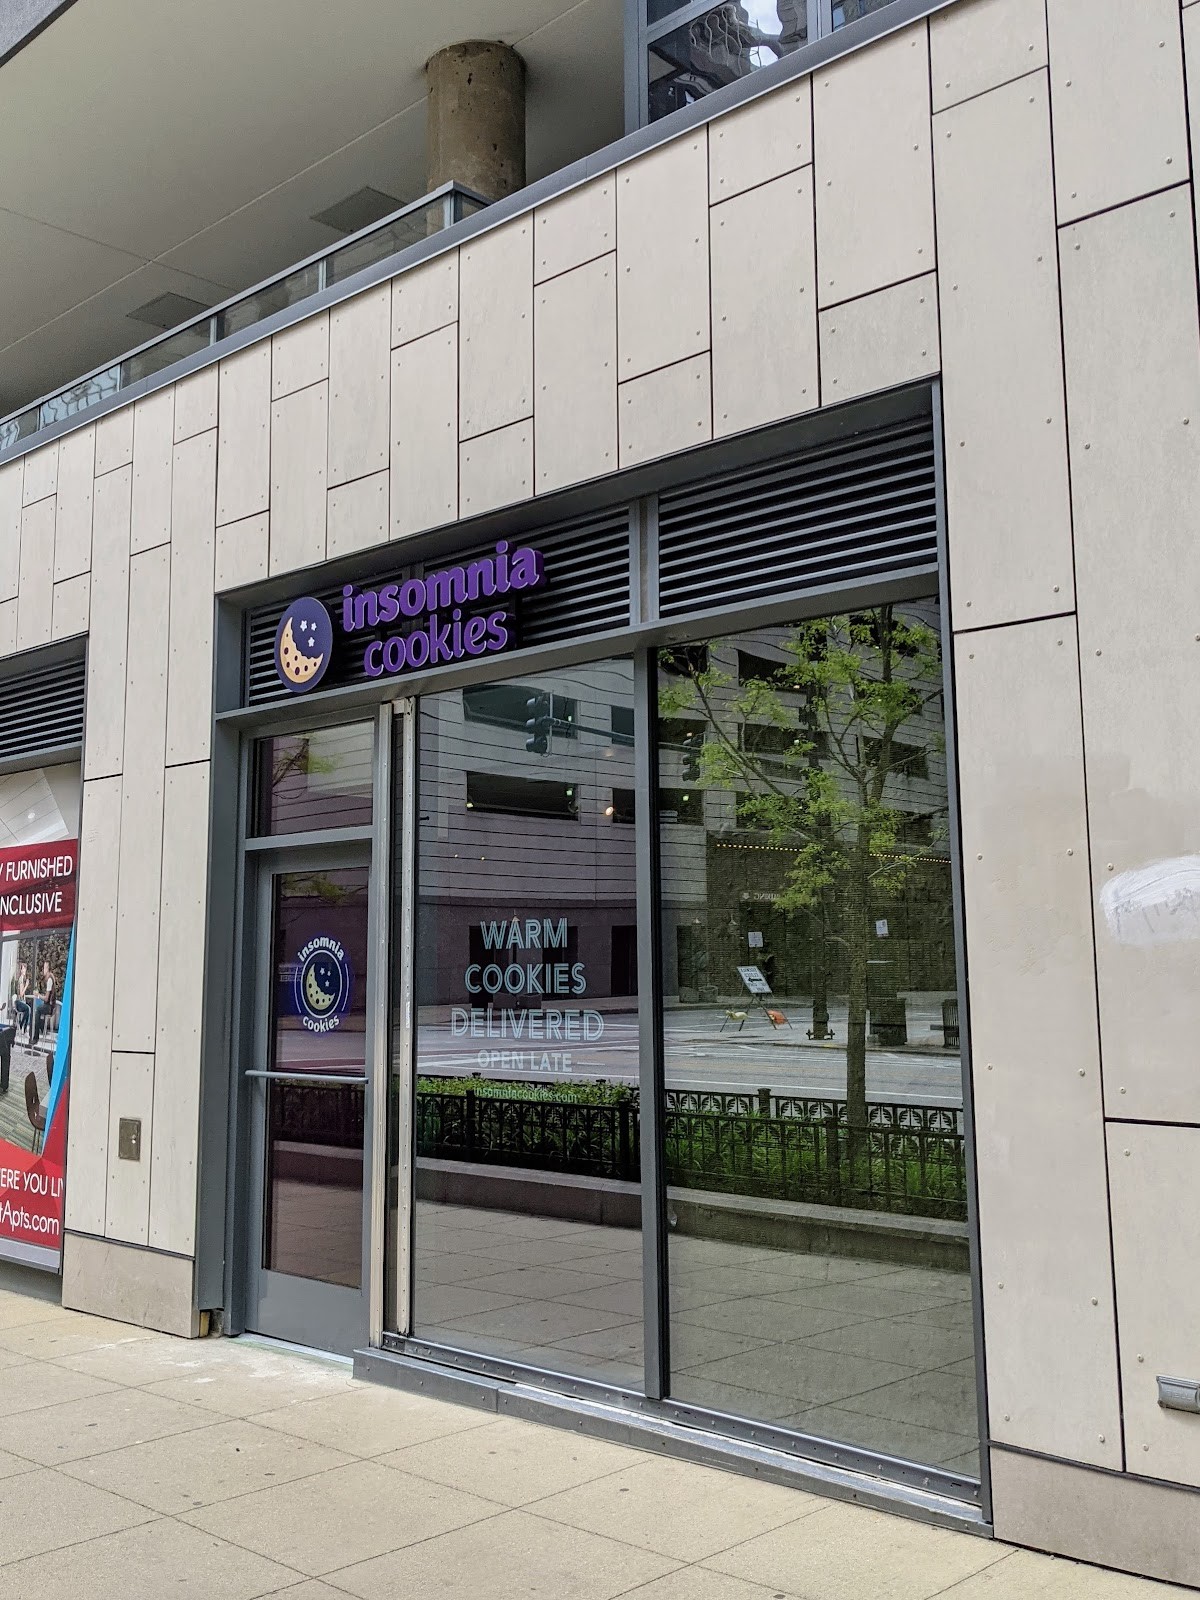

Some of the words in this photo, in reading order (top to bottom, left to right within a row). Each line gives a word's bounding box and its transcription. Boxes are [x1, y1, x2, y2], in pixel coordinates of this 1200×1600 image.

[342, 540, 541, 632] insomnia
[363, 608, 511, 677] cookies
[6, 855, 73, 881] FURNISHED
[480, 917, 568, 949] WARM
[297, 937, 345, 962] insomnia
[464, 962, 587, 994] COOKIES
[302, 1015, 340, 1033] cookies
[451, 1007, 604, 1041] DELIVERED
[477, 1050, 524, 1070] OPEN
[530, 1052, 573, 1072] LATE
[23, 1172, 48, 1195] YOU
